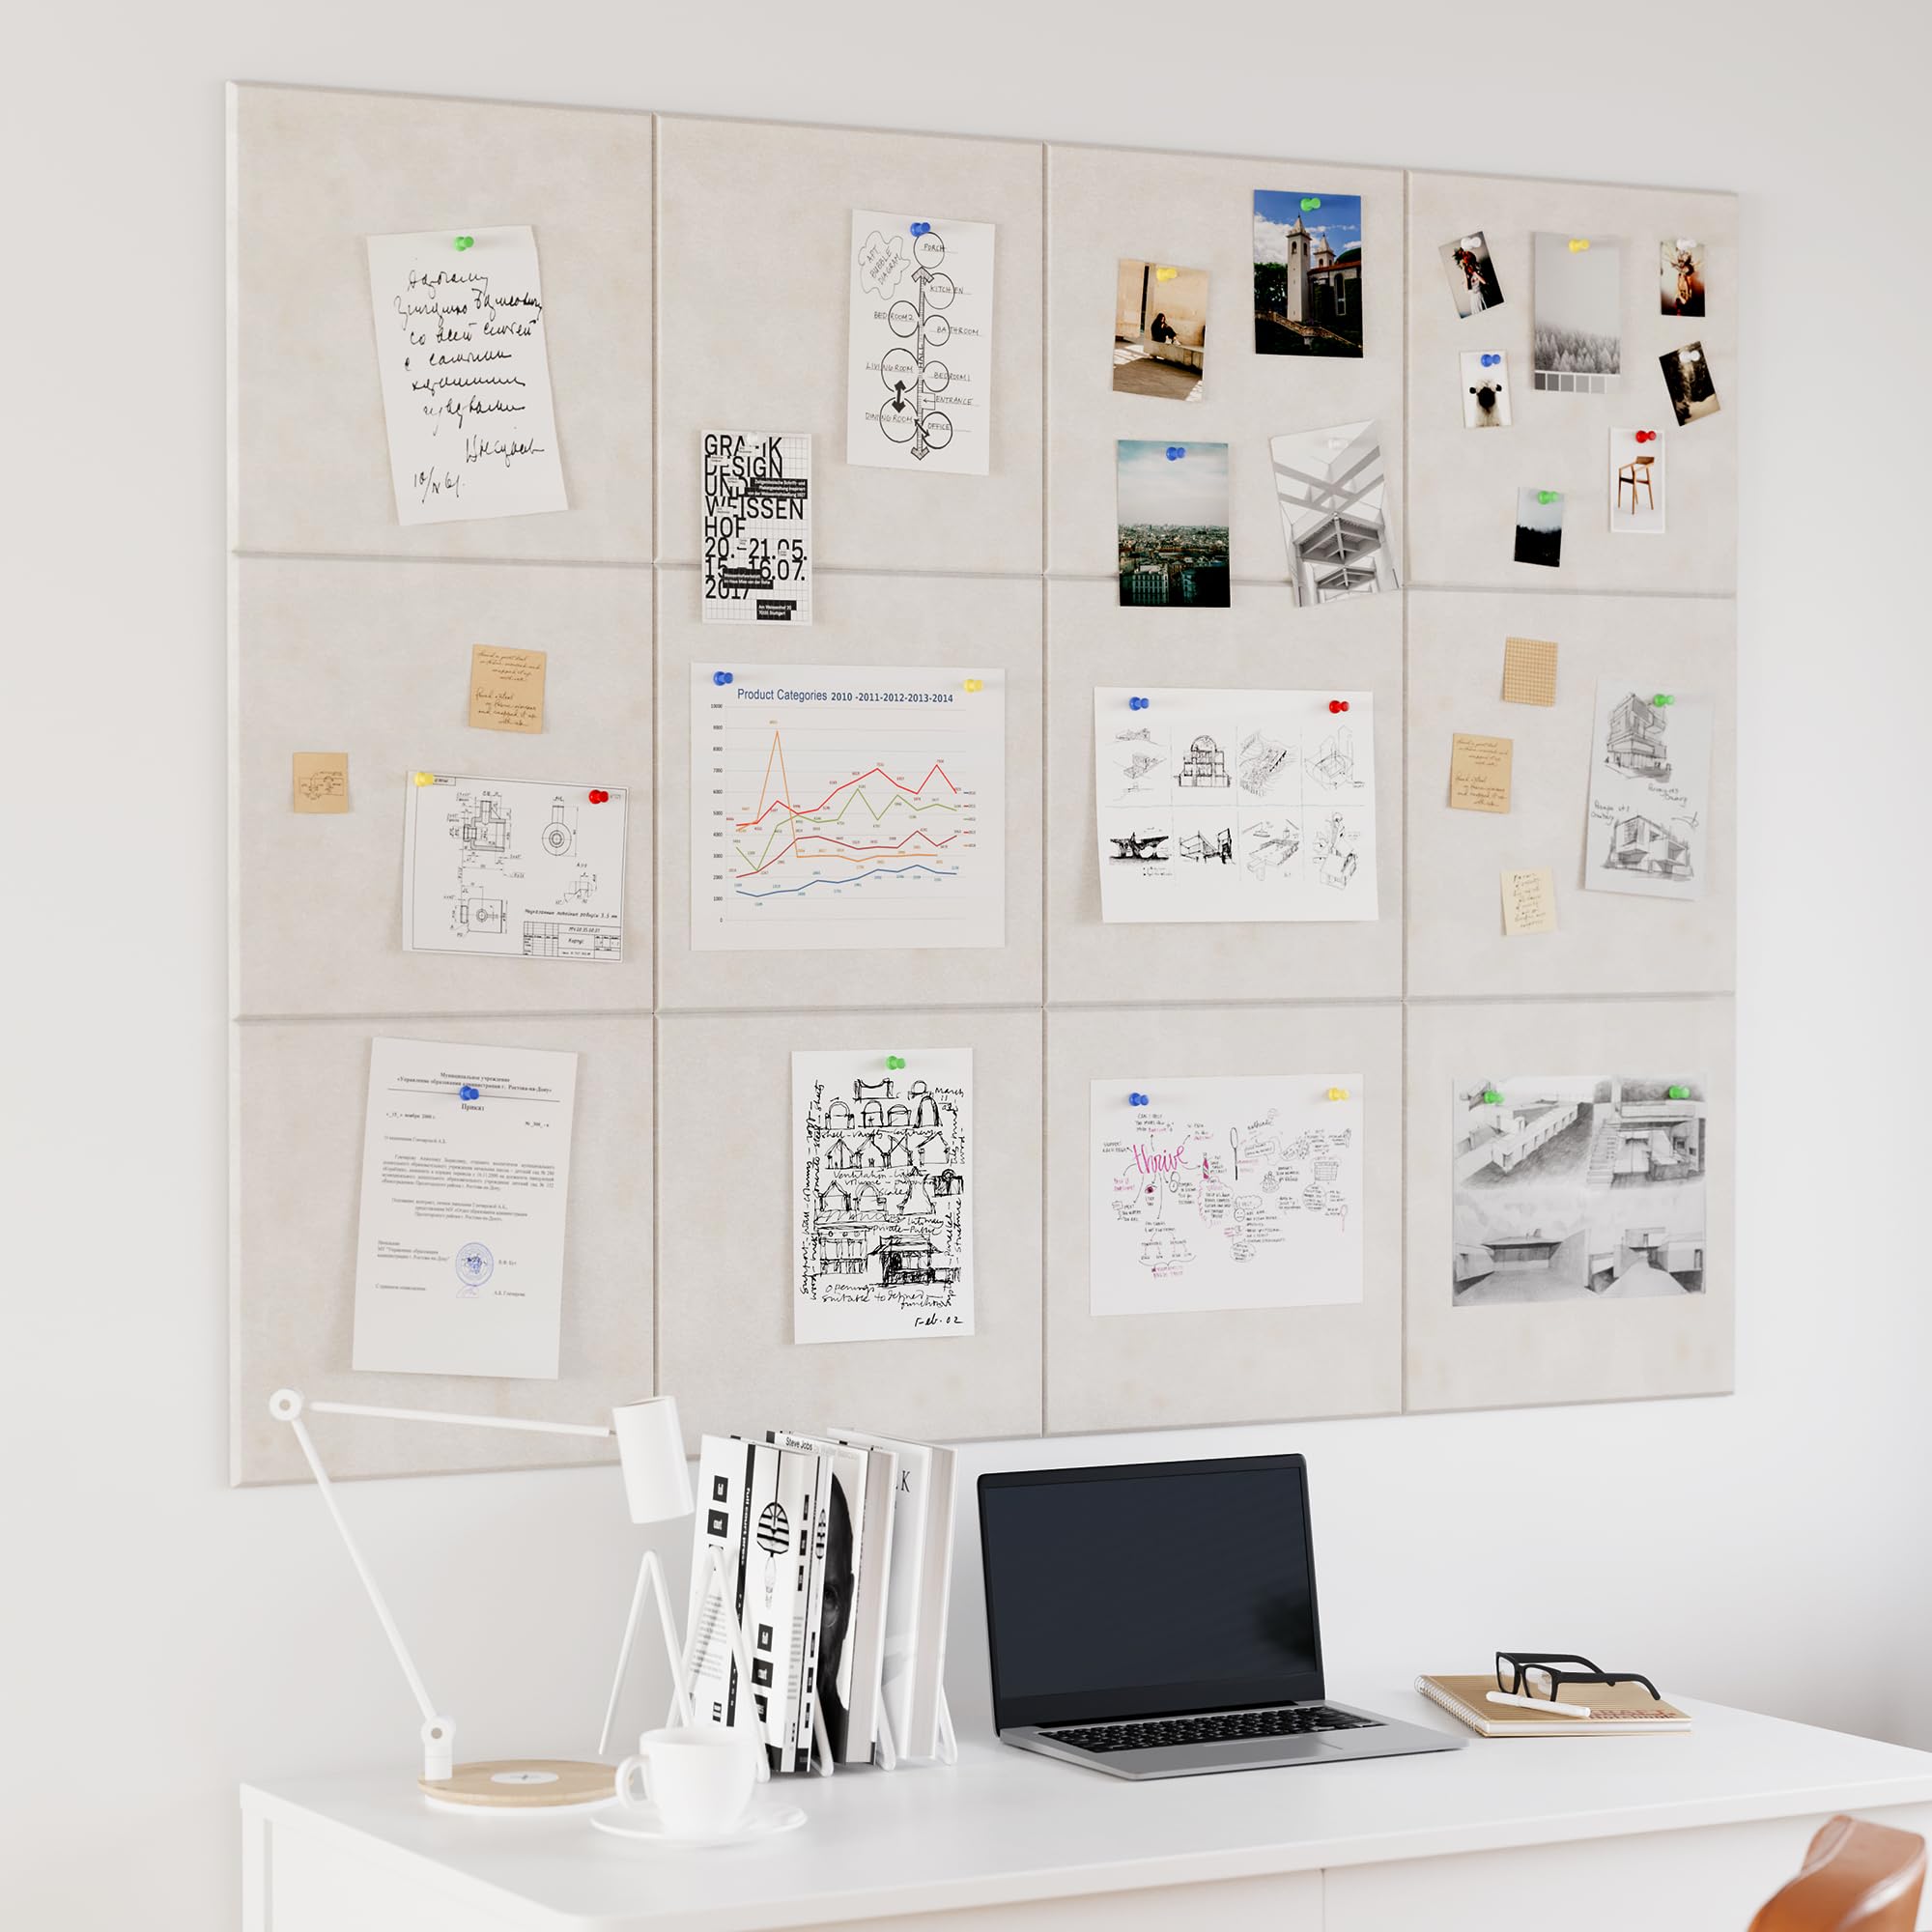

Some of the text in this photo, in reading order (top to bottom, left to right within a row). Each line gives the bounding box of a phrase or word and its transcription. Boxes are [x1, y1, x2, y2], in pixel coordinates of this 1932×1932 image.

[869, 246, 893, 279] BUBBLE
[878, 253, 901, 286] DIAGRAM
[929, 285, 964, 295] KITCHEN
[936, 326, 980, 336] BATHROOM
[935, 395, 974, 406] ENTRANCE
[927, 422, 952, 431] OFFICE
[704, 434, 782, 456] GRAIK
[705, 455, 782, 478] DESIGN
[705, 496, 804, 520] WEISSEN
[705, 516, 747, 538] HOF
[737, 688, 774, 700] Product
[777, 689, 828, 702] Categories
[831, 692, 853, 701] 2010
[935, 1087, 965, 1097] March
[1133, 1144, 1189, 1175] thrive
[785, 1436, 813, 1451] Steve Jobs
